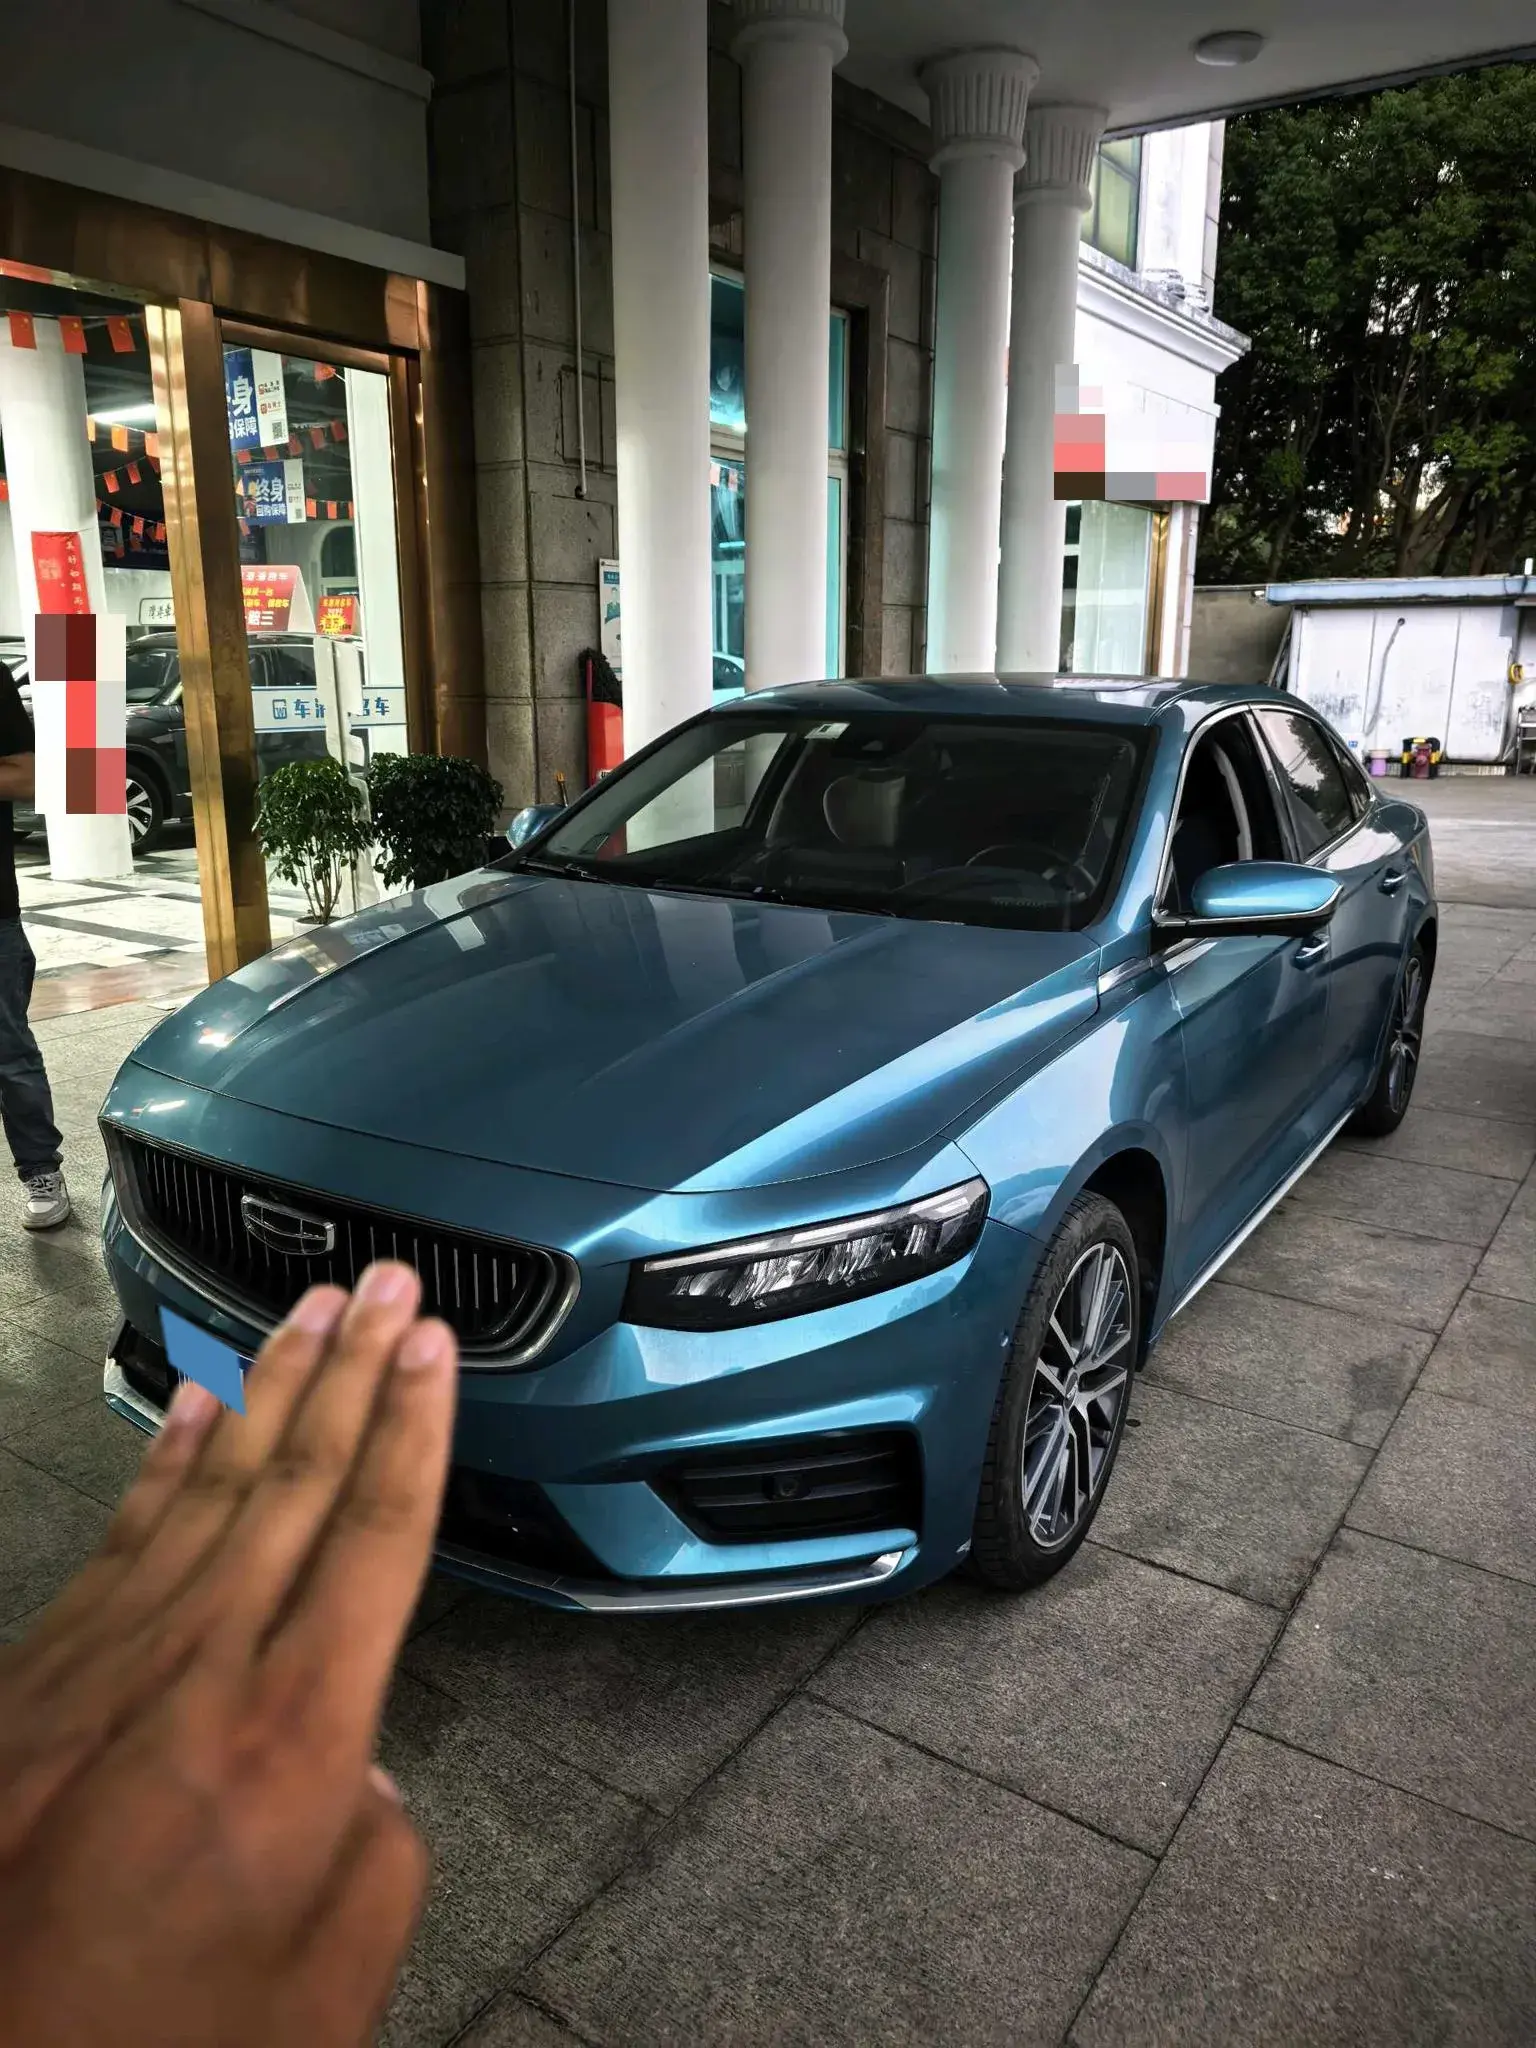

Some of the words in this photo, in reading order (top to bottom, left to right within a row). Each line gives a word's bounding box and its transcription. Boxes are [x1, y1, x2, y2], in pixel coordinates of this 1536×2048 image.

[226, 376, 253, 416] 身
[256, 477, 284, 502] 终身
[245, 610, 274, 626] 赔三
